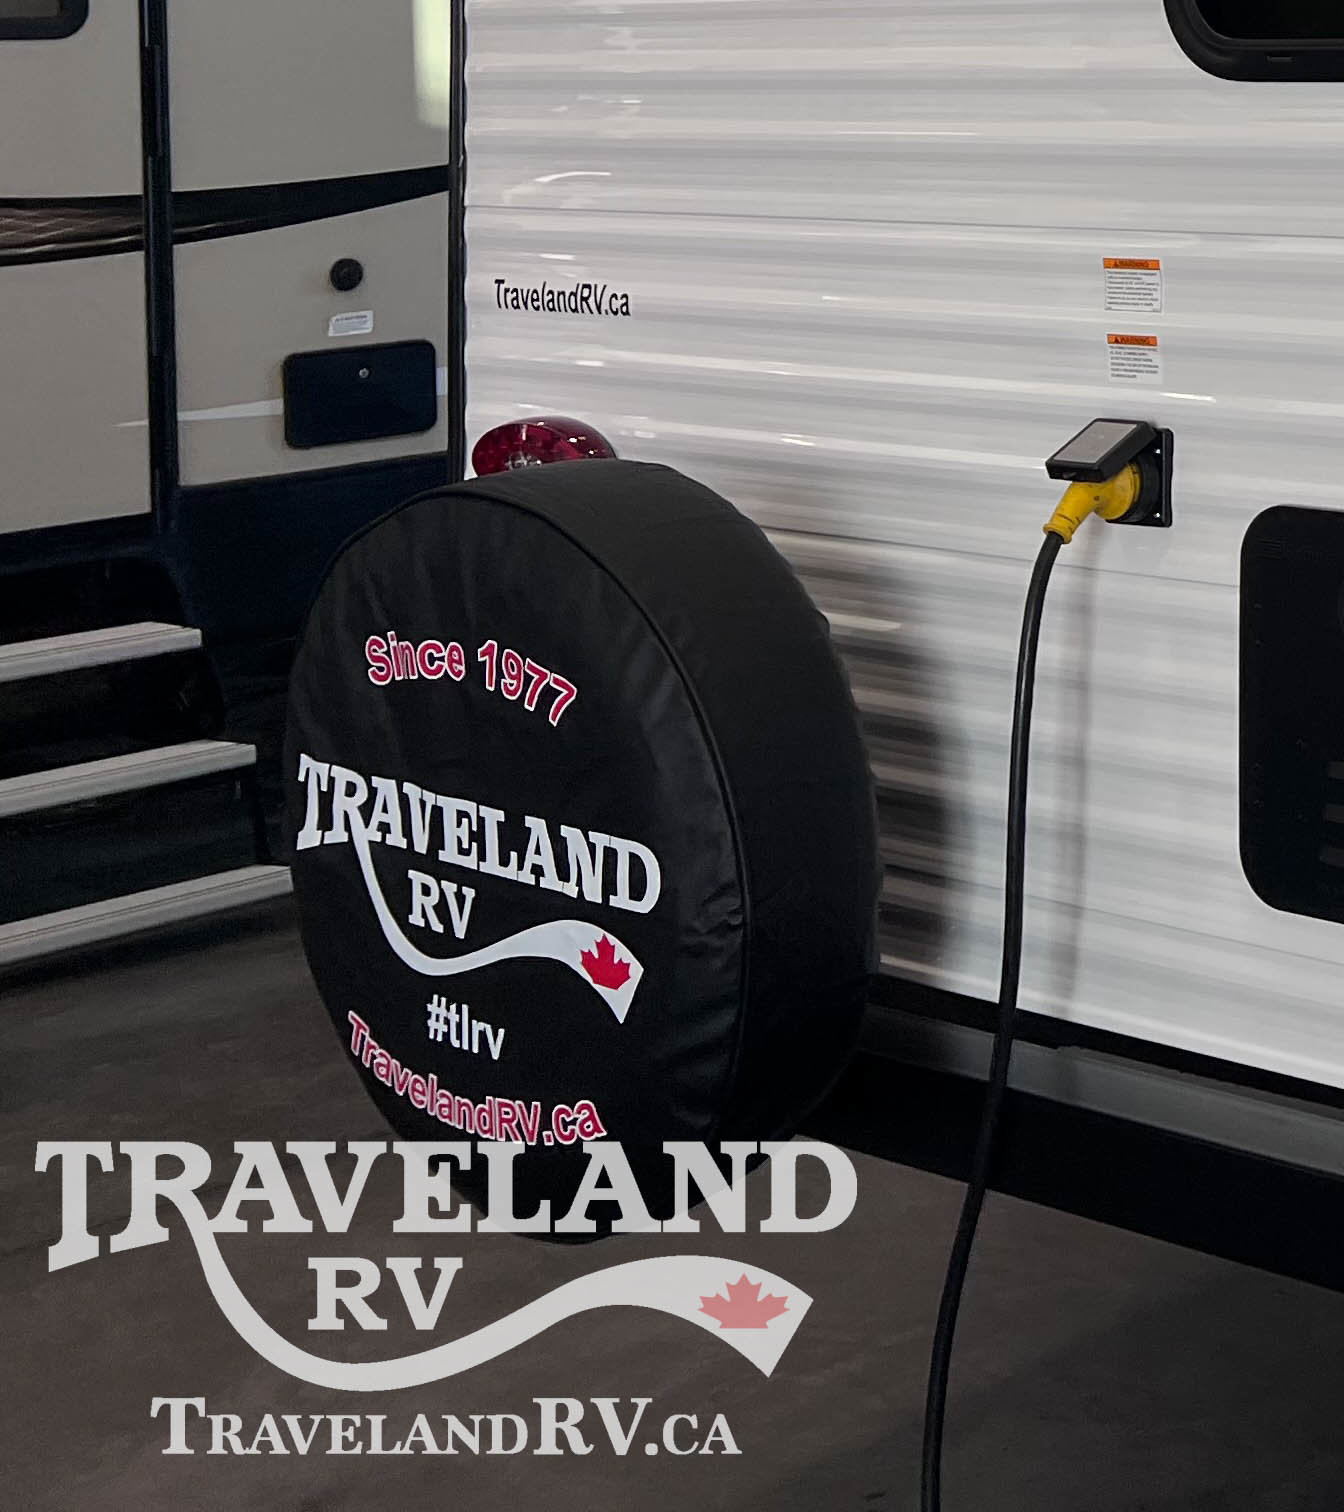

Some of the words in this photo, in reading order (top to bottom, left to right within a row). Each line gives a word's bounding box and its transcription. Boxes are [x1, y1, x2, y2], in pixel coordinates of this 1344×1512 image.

[494, 278, 631, 317] TravelandRV.ca
[365, 631, 466, 685] Since
[476, 640, 578, 727] 1977
[296, 753, 662, 914] TRAVELAND
[407, 869, 476, 940] RV
[426, 994, 505, 1061] #tlrv
[346, 1010, 608, 1146] TravelandRV.ca
